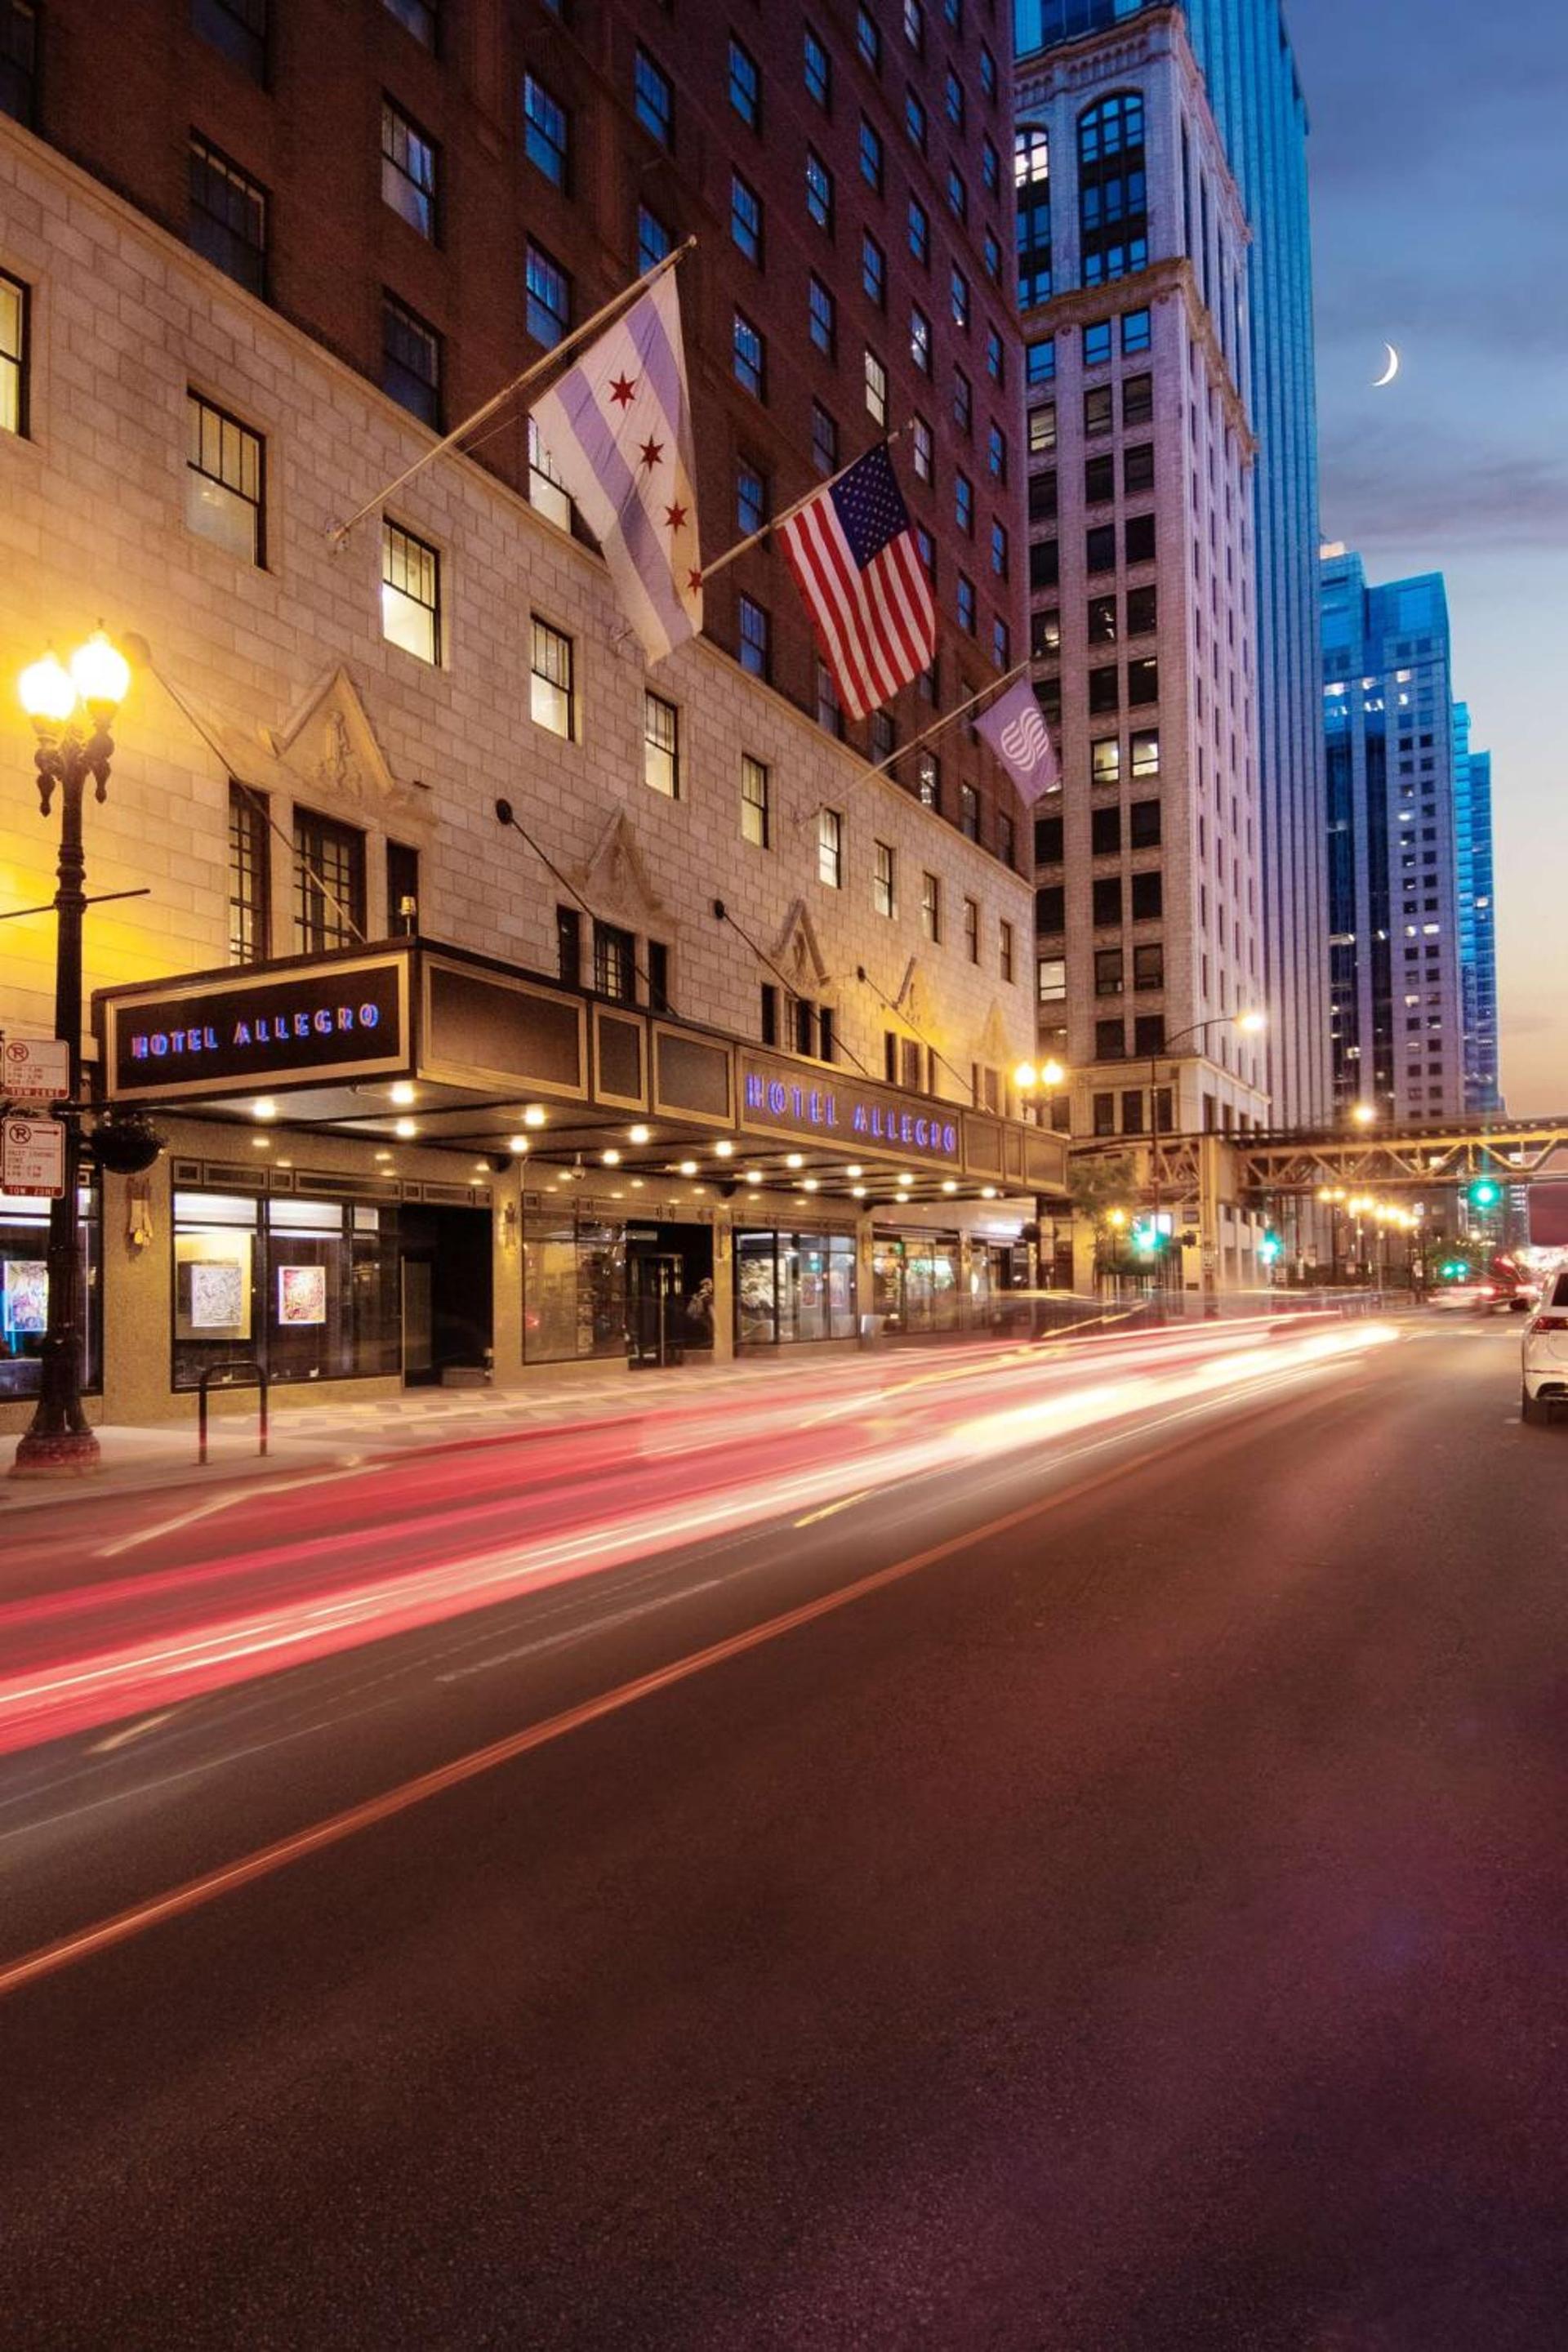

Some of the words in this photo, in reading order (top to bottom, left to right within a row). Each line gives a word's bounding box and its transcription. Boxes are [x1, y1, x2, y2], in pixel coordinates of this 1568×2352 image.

[131, 1026, 218, 1059] HOTEL
[234, 1003, 380, 1045] ALLEGRO
[746, 1072, 839, 1128] HOTEL
[853, 1103, 956, 1152] ALLEGRO
